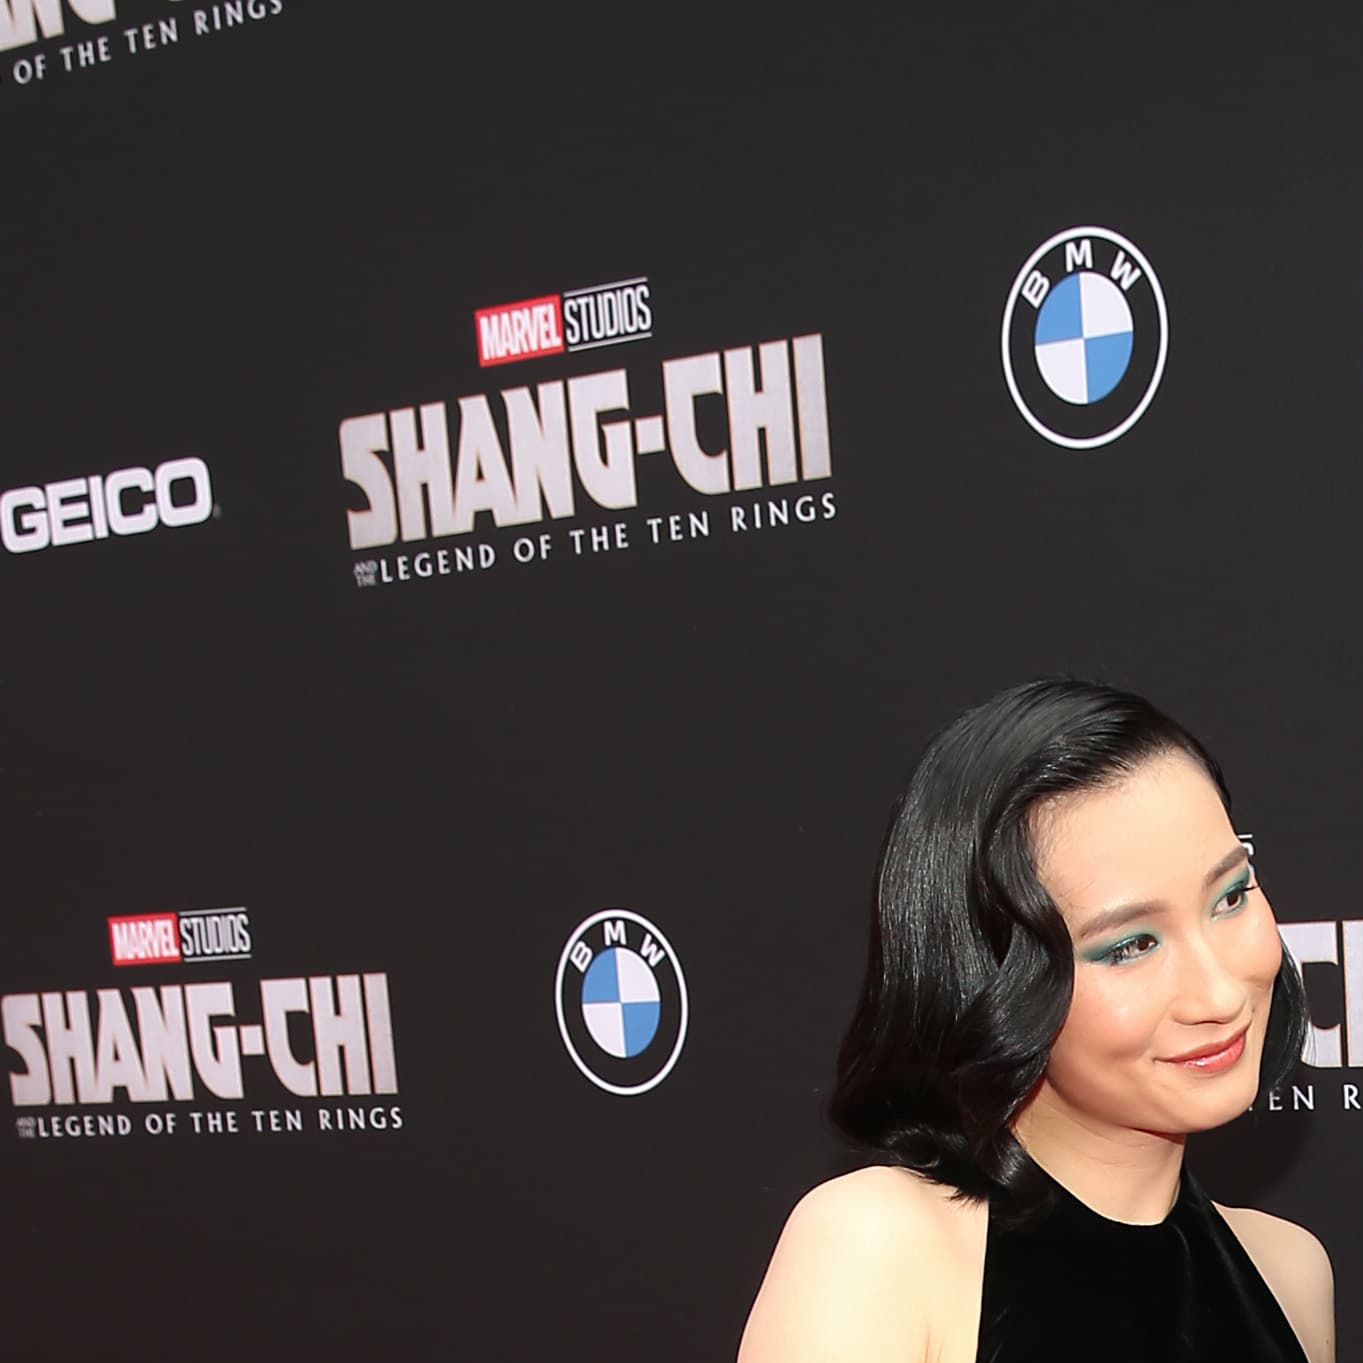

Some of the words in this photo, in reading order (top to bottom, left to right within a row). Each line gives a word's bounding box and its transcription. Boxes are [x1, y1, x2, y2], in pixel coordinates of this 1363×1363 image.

[14, 55, 44, 83] OF
[60, 37, 110, 70] THE
[125, 19, 177, 53] TEN
[1021, 238, 1142, 309] BMW
[479, 303, 562, 360] MARVEL
[564, 285, 652, 345] STUDIOS
[340, 334, 831, 549] SHANG-CHI
[0, 457, 212, 553] GEICO
[381, 544, 495, 582] LEGEND
[514, 535, 551, 562] OF
[569, 523, 628, 554] THE
[647, 511, 708, 543] TEN
[731, 493, 835, 531] RINGS
[112, 919, 180, 960] MARVEL
[180, 914, 251, 955] STUDIOS
[569, 920, 666, 973] BMW
[2, 973, 397, 1105] SHANG-CHI
[38, 1115, 131, 1137] LEGEND
[146, 1113, 175, 1135] OF
[190, 1112, 238, 1133] THE
[252, 1110, 302, 1131] TEN
[319, 1107, 402, 1130] RINGS
[1269, 1086, 1315, 1111] EN
